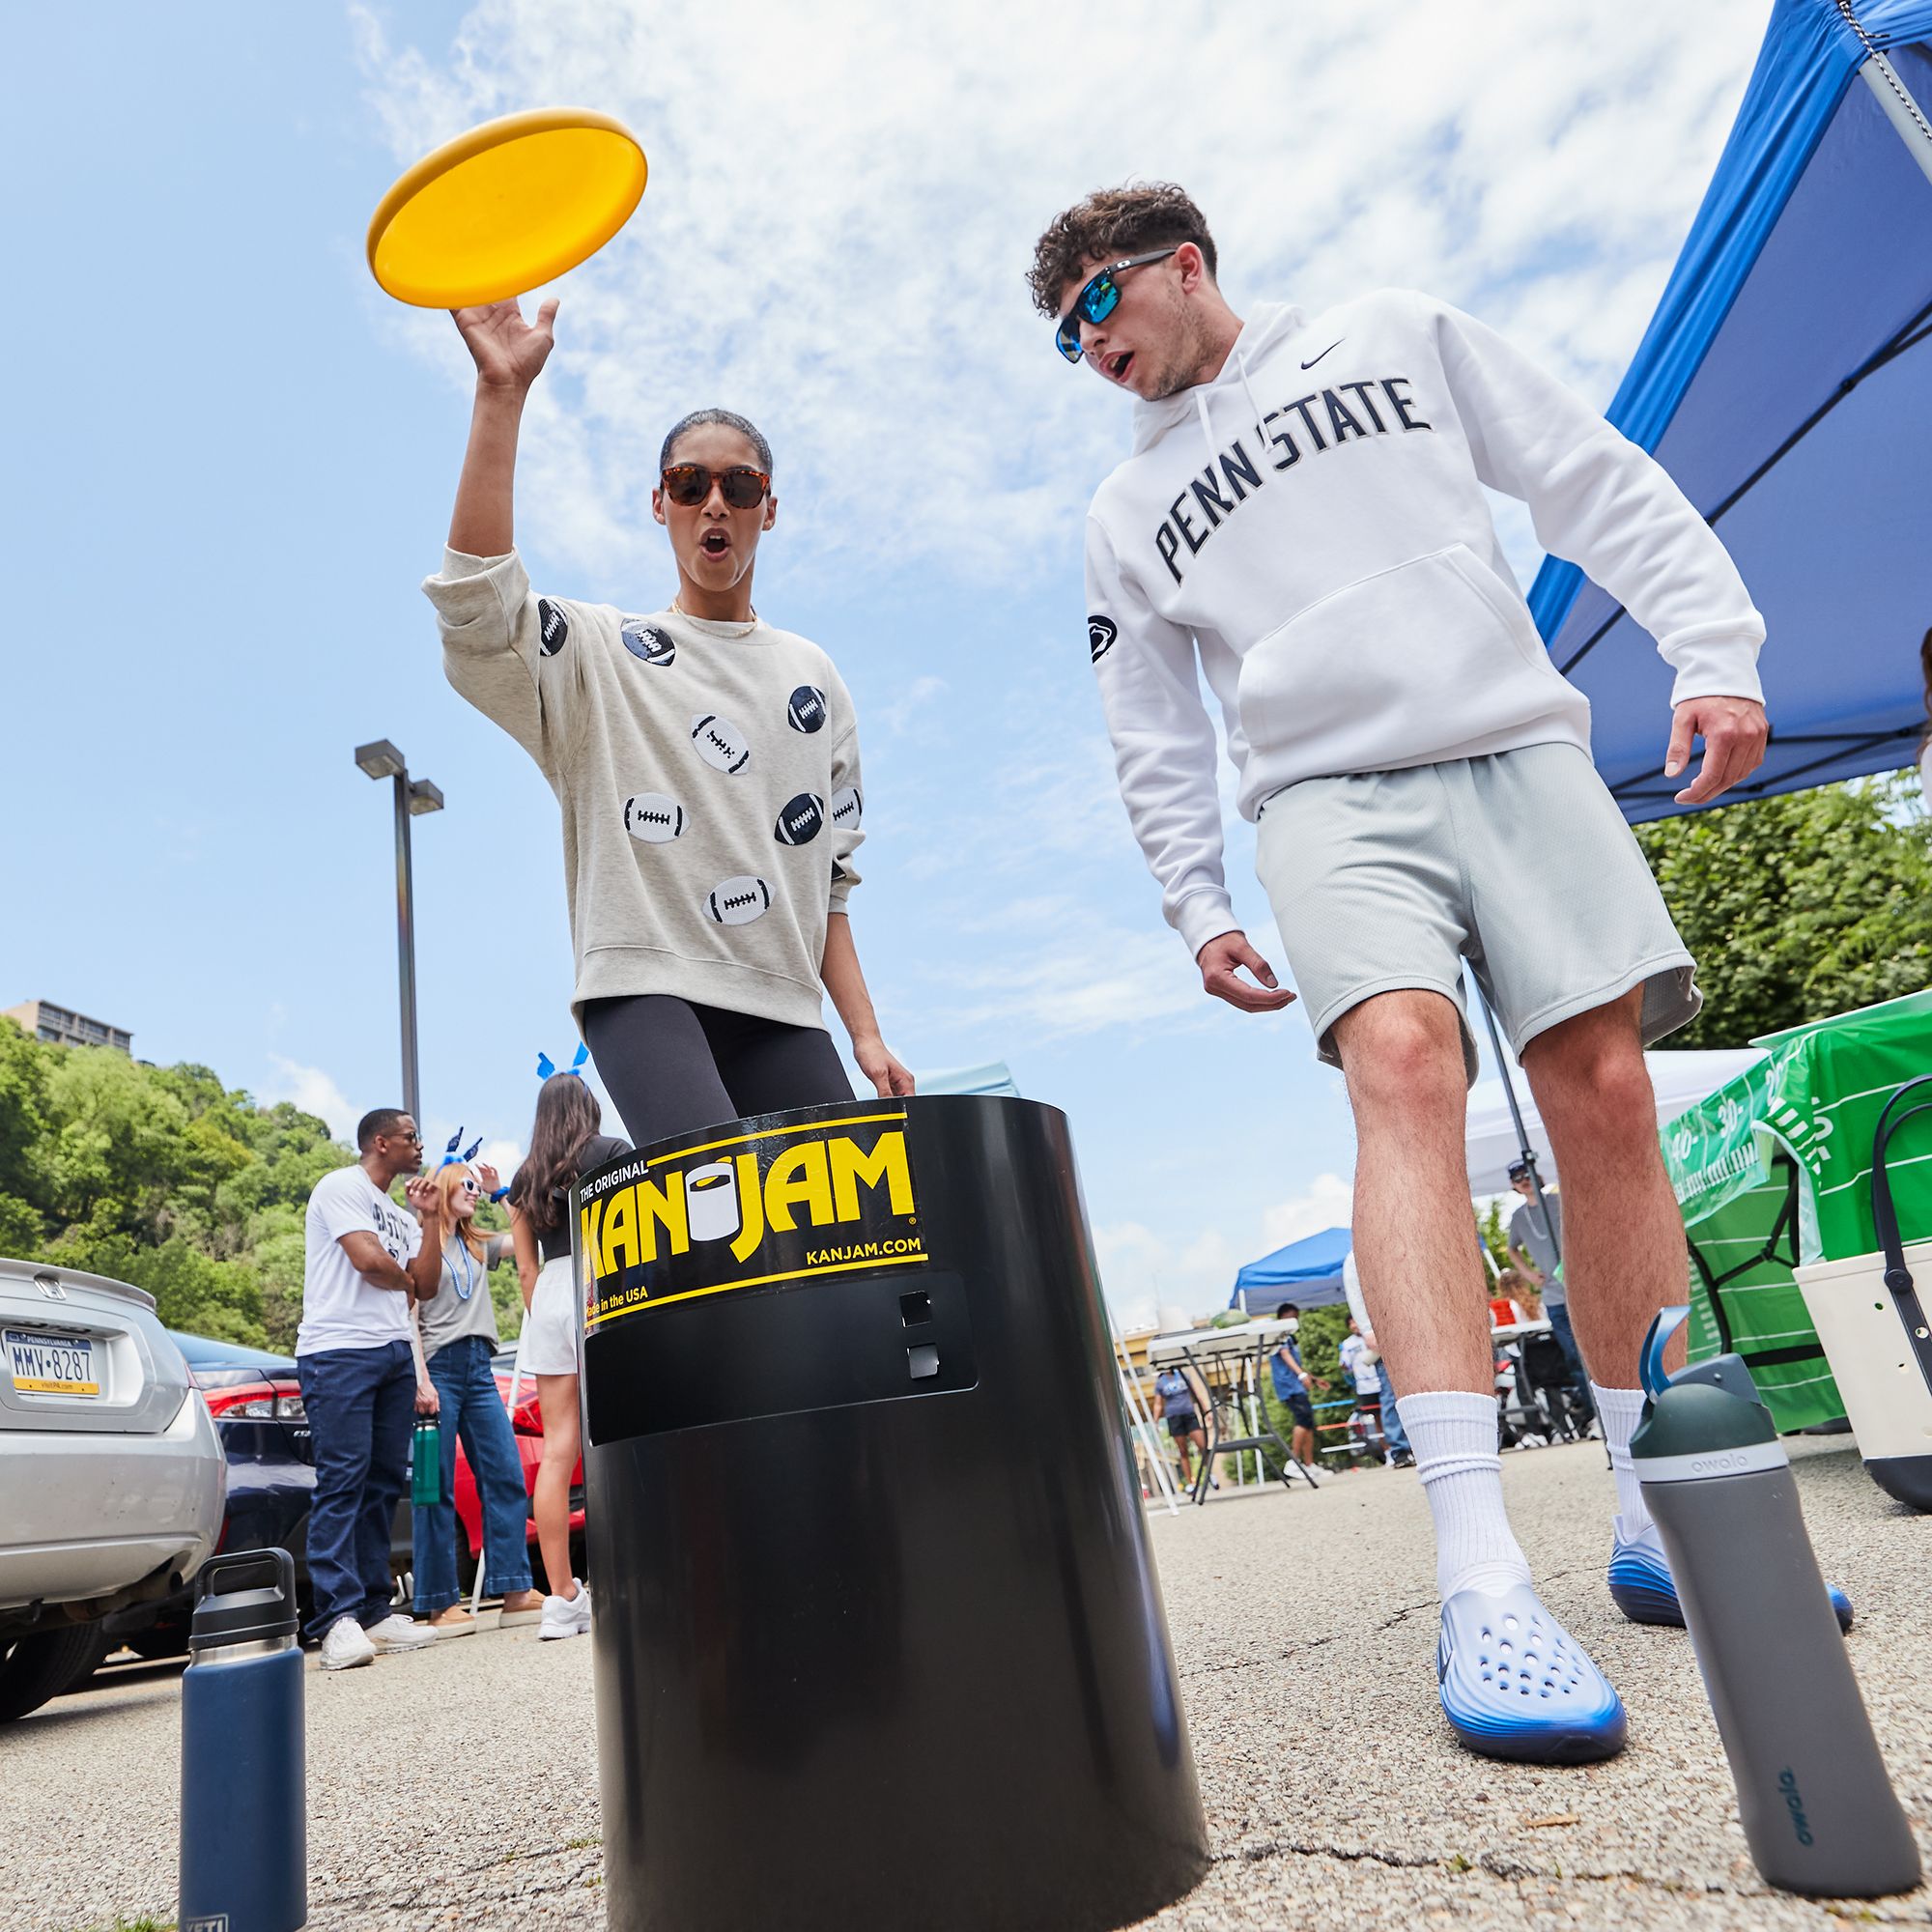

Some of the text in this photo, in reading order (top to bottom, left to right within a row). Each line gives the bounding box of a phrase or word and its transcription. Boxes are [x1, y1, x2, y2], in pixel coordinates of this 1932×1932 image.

[1154, 378, 1431, 587] PENN STATE
[580, 1159, 649, 1204] THE ORIGINAL
[806, 1236, 922, 1265] KANJAM.COM
[601, 1298, 609, 1311] in
[610, 1294, 624, 1308] the
[626, 1286, 648, 1303] USA
[27, 1336, 72, 1347] PENNSYLVANIA
[1778, 1764, 1814, 1848] owala
